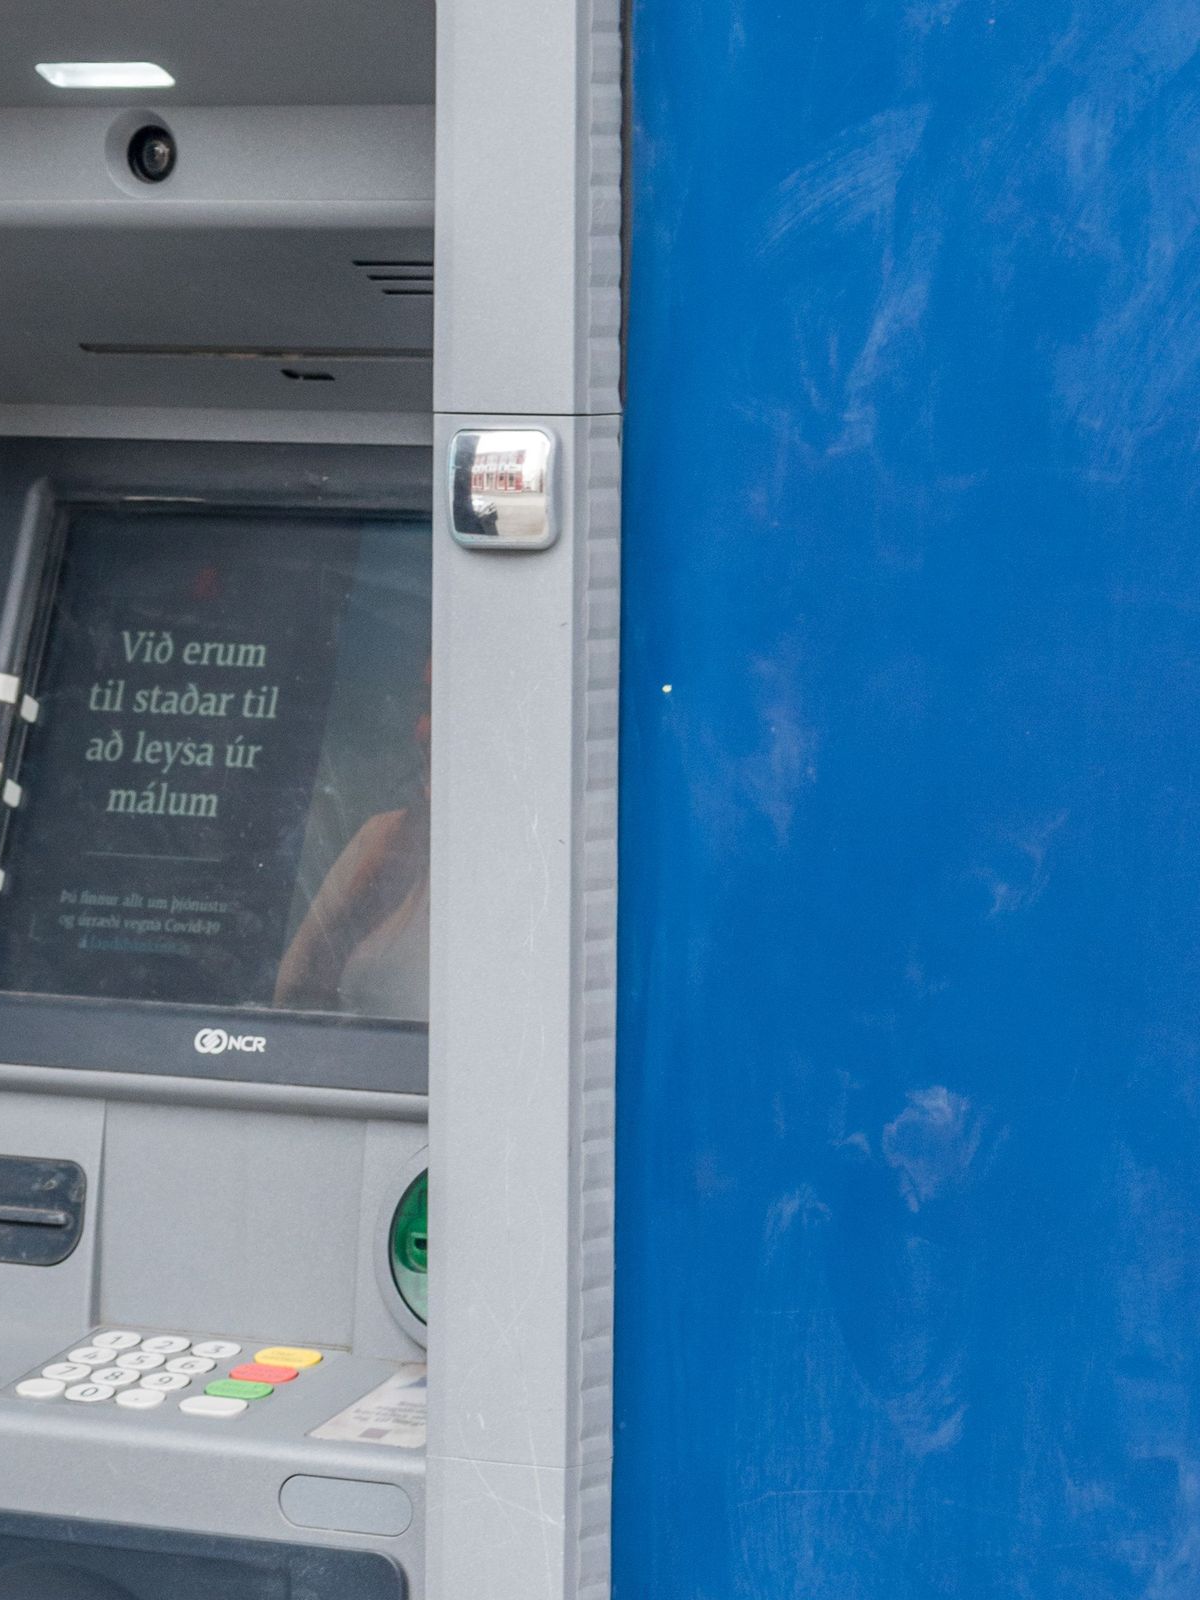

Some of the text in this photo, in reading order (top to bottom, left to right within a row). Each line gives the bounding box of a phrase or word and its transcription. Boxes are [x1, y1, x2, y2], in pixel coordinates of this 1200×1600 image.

[121, 630, 267, 668] Við erum
[88, 679, 279, 719] til staðar til
[85, 729, 262, 774] að leysa úr
[105, 781, 219, 818] málum
[147, 898, 168, 909] um
[226, 1035, 267, 1053] NCR
[155, 1340, 174, 1350] 2
[208, 1345, 226, 1354] 3
[132, 1356, 150, 1365] 5
[180, 1361, 198, 1370] 6
[57, 1366, 174, 1386] 7 8 9
[80, 1387, 98, 1398] 0
